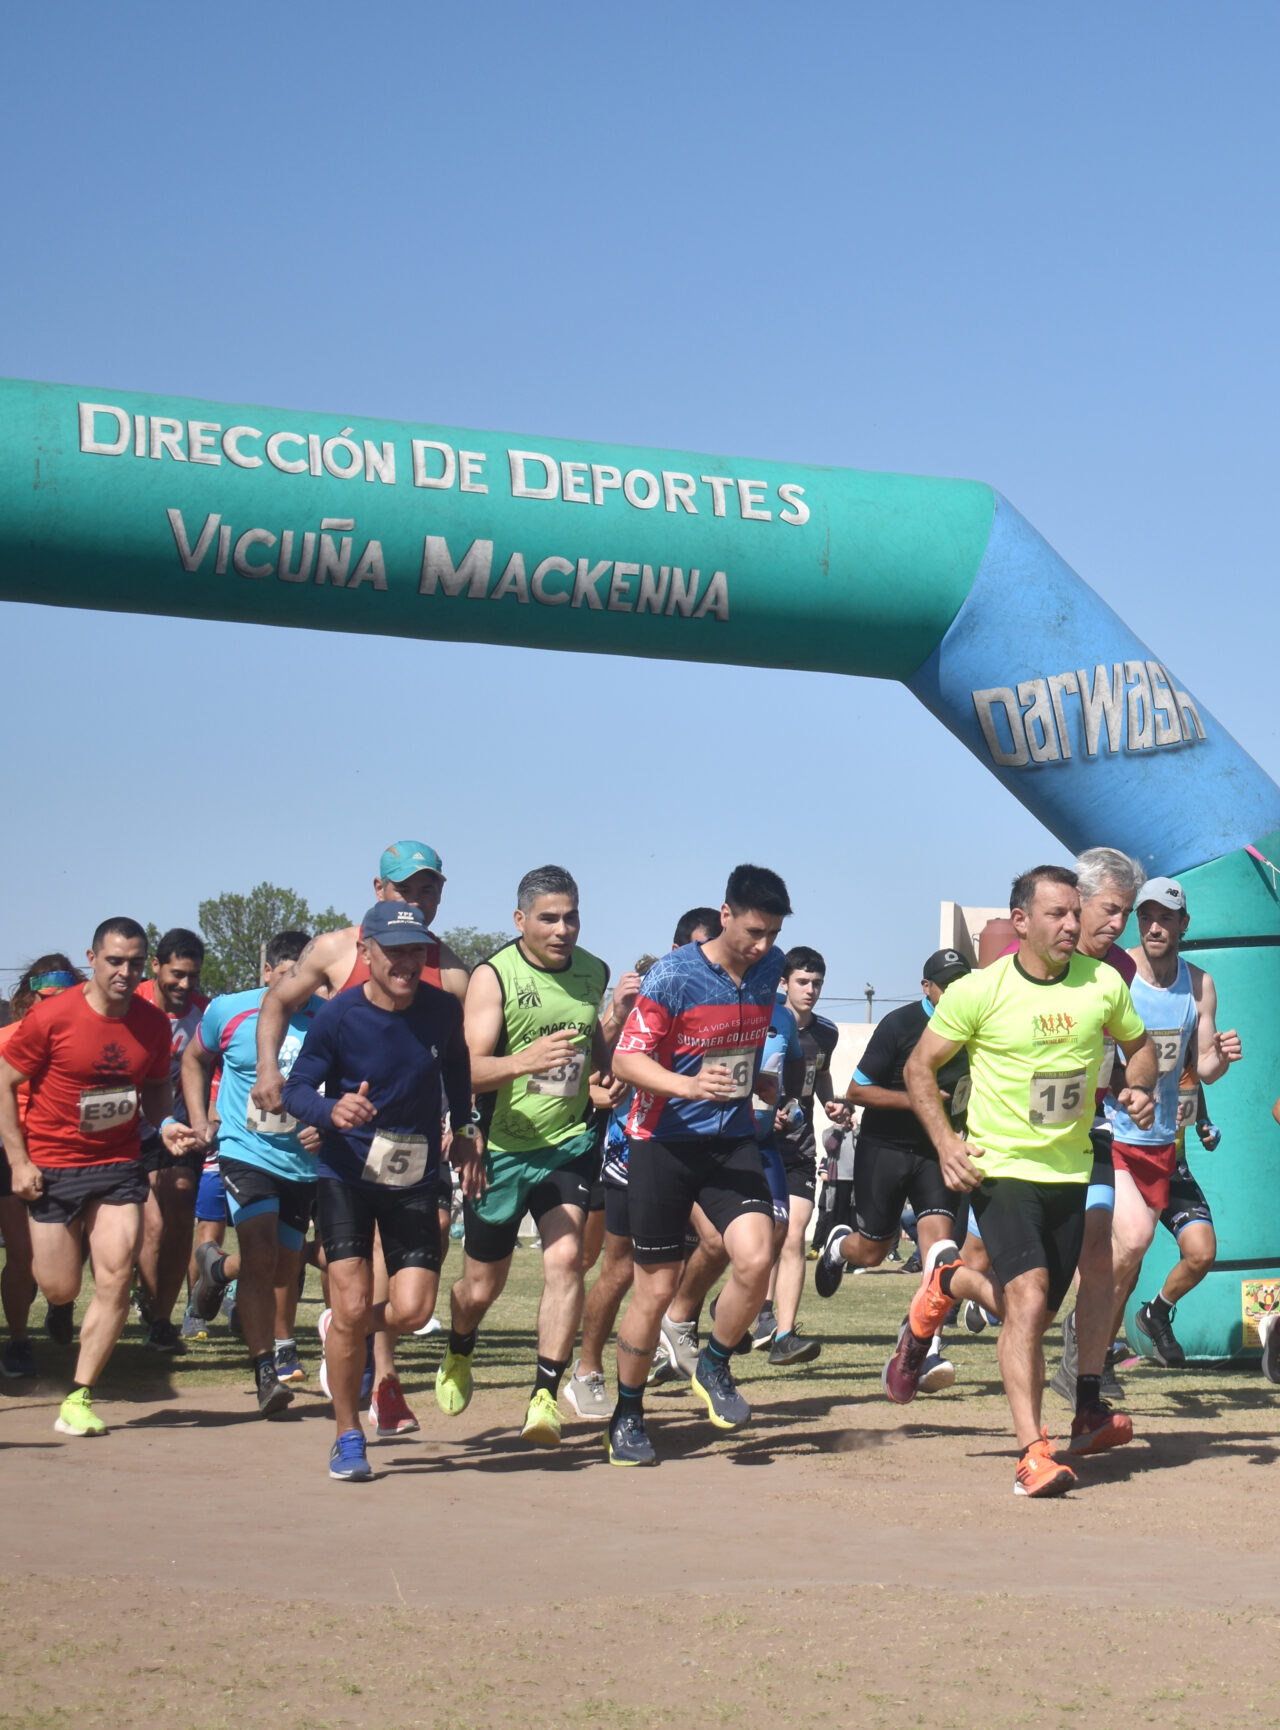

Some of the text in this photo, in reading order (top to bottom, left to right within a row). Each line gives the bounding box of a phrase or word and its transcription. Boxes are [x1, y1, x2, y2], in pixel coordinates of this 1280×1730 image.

[78, 402, 811, 526] DIRECCIÓN DE DEPORTES
[166, 508, 730, 622] VICUÑA MACKENNA
[540, 1022, 593, 1038] MARATO
[711, 1023, 730, 1031] VIDA
[677, 1032, 724, 1048] SUMMER
[1040, 1082, 1080, 1112] 15
[85, 1100, 134, 1121] E30
[387, 1149, 412, 1175] 5
